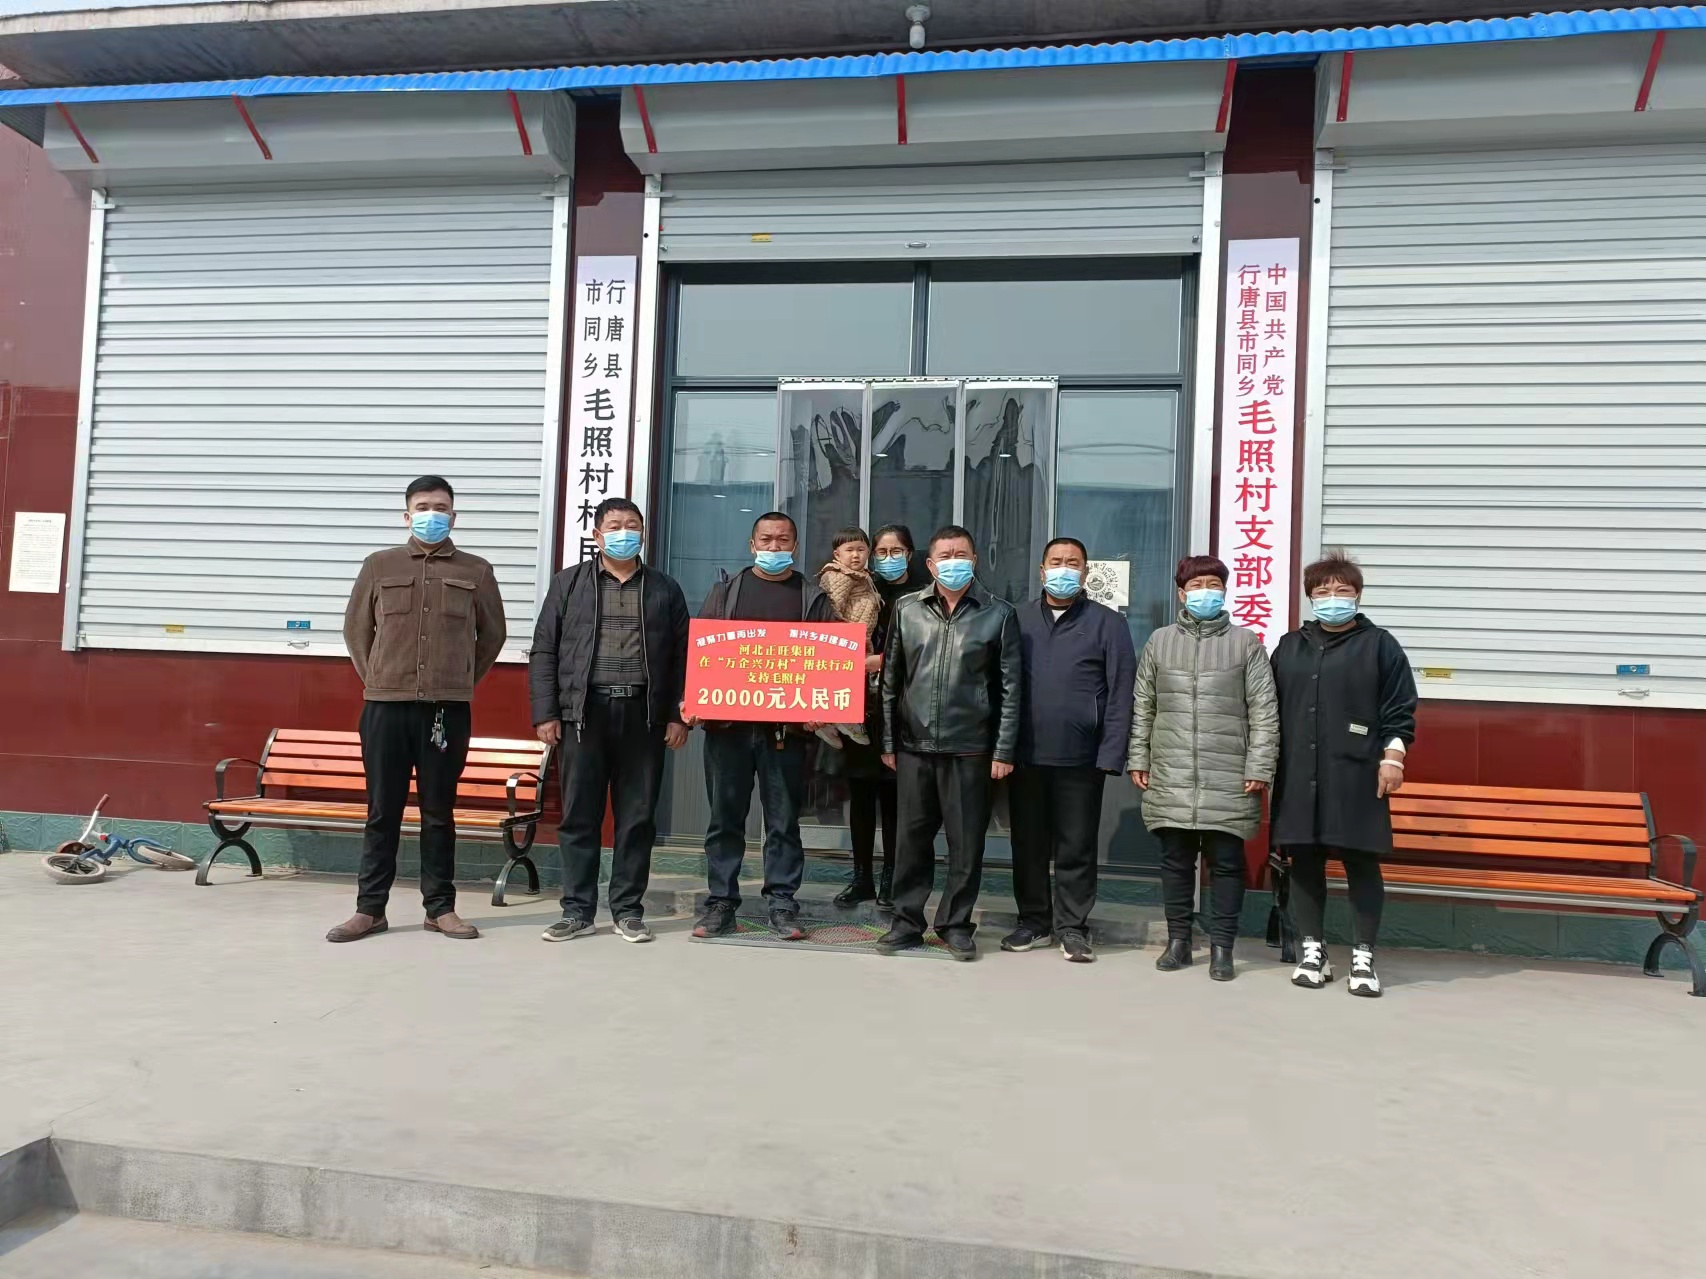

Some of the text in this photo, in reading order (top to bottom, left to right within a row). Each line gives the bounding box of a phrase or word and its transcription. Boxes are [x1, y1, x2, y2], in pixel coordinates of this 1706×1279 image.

[582, 278, 604, 379] 市同乡
[603, 278, 627, 380] 行唐县
[1236, 264, 1262, 398] 行唐县市同乡
[1263, 262, 1287, 397] 中国共产党
[1231, 399, 1278, 645] 毛照村支部委
[697, 686, 852, 711] 20000元人民币
[738, 644, 816, 658] 河北正旺集团
[746, 671, 807, 685] 支持毛照村
